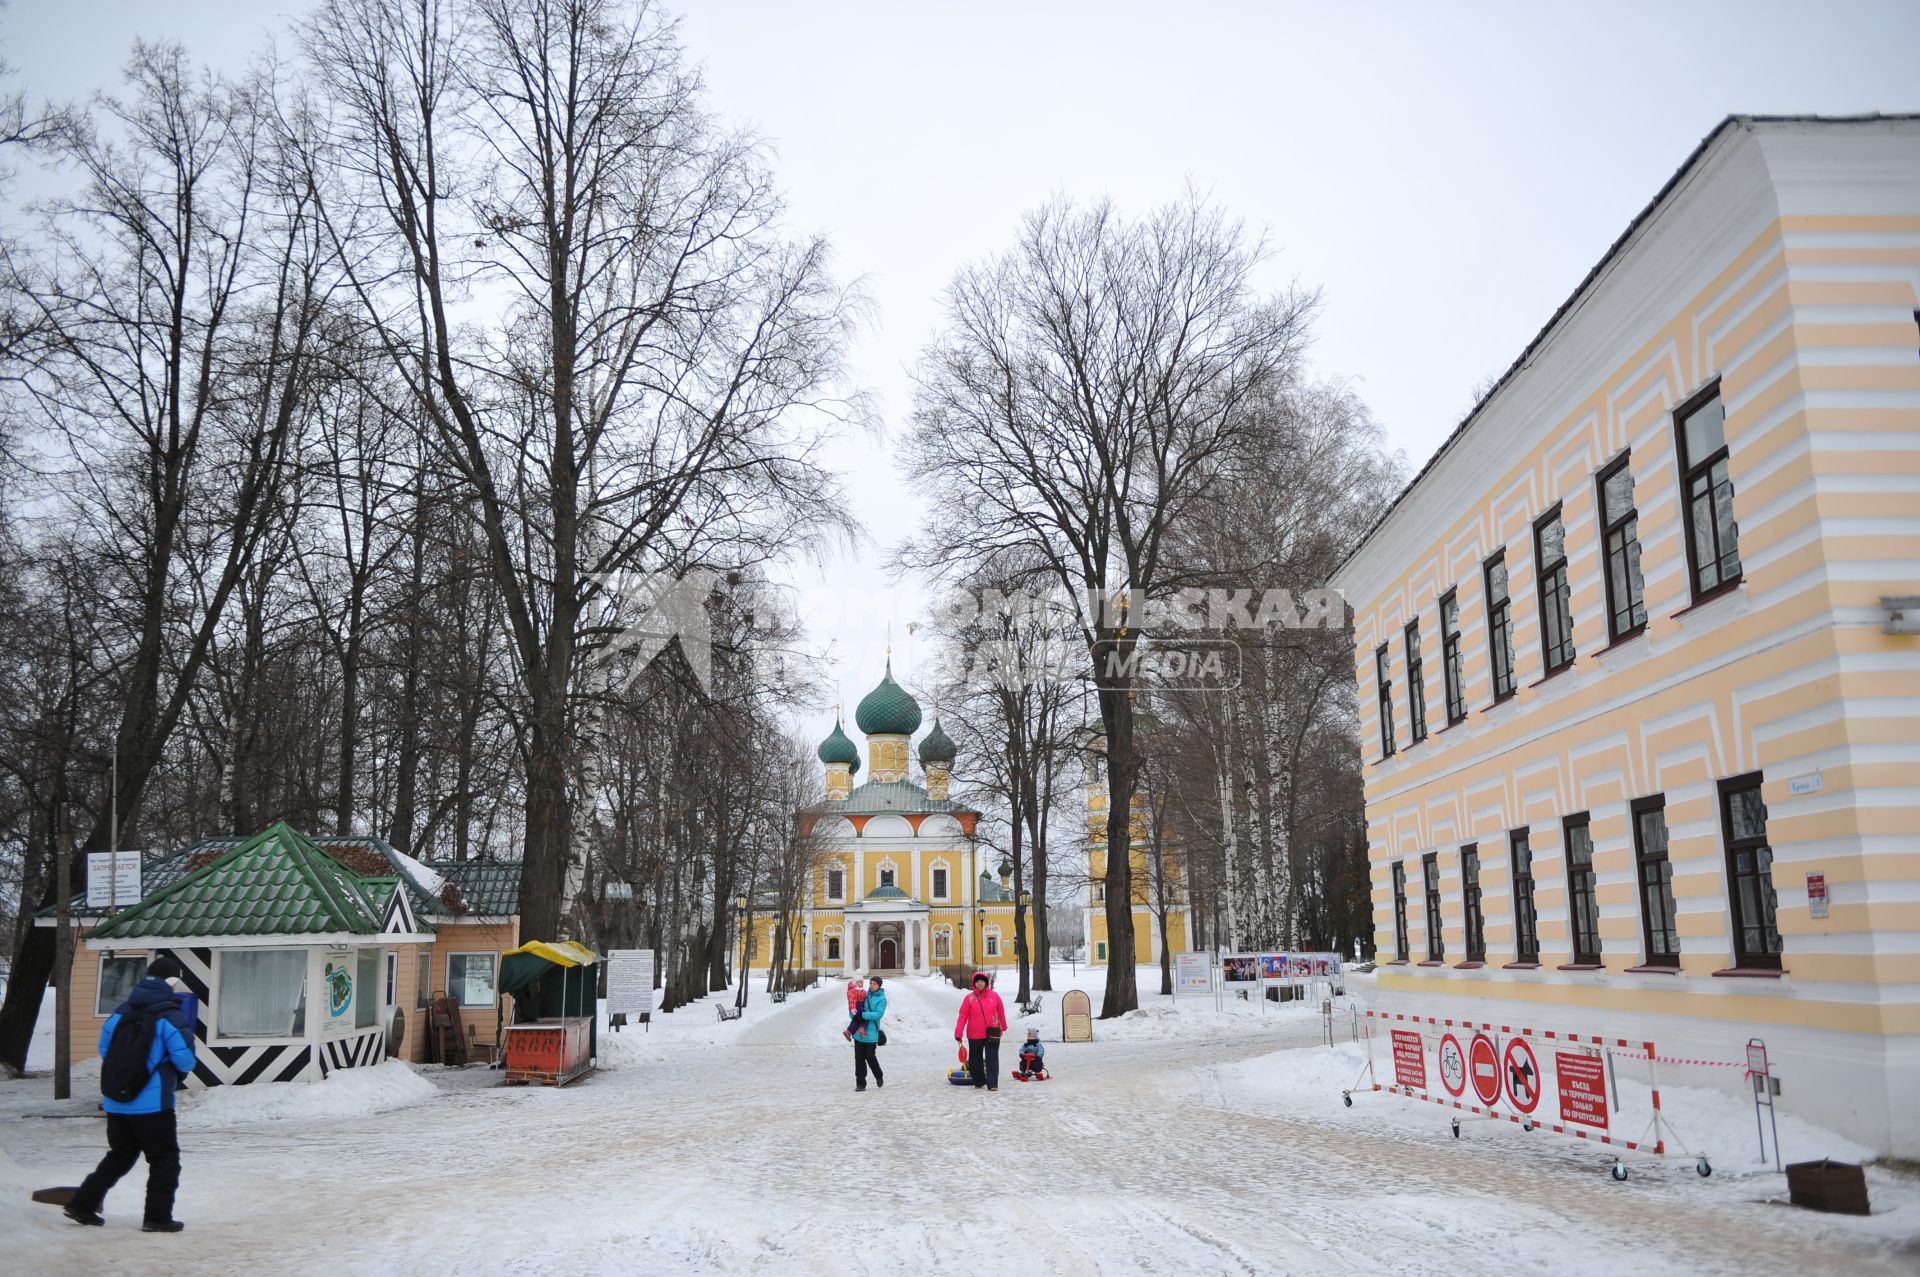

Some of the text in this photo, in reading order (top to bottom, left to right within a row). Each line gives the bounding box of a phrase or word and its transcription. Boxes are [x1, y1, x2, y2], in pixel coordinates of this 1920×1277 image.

[1571, 1080, 1591, 1091] ВЪЕЗД
[1560, 1088, 1605, 1104] НА ТЕРРИТОРИЮ
[1571, 1100, 1593, 1112] ТОЛЬКО
[1563, 1108, 1605, 1124] ПО ПРОПУСКАМ
